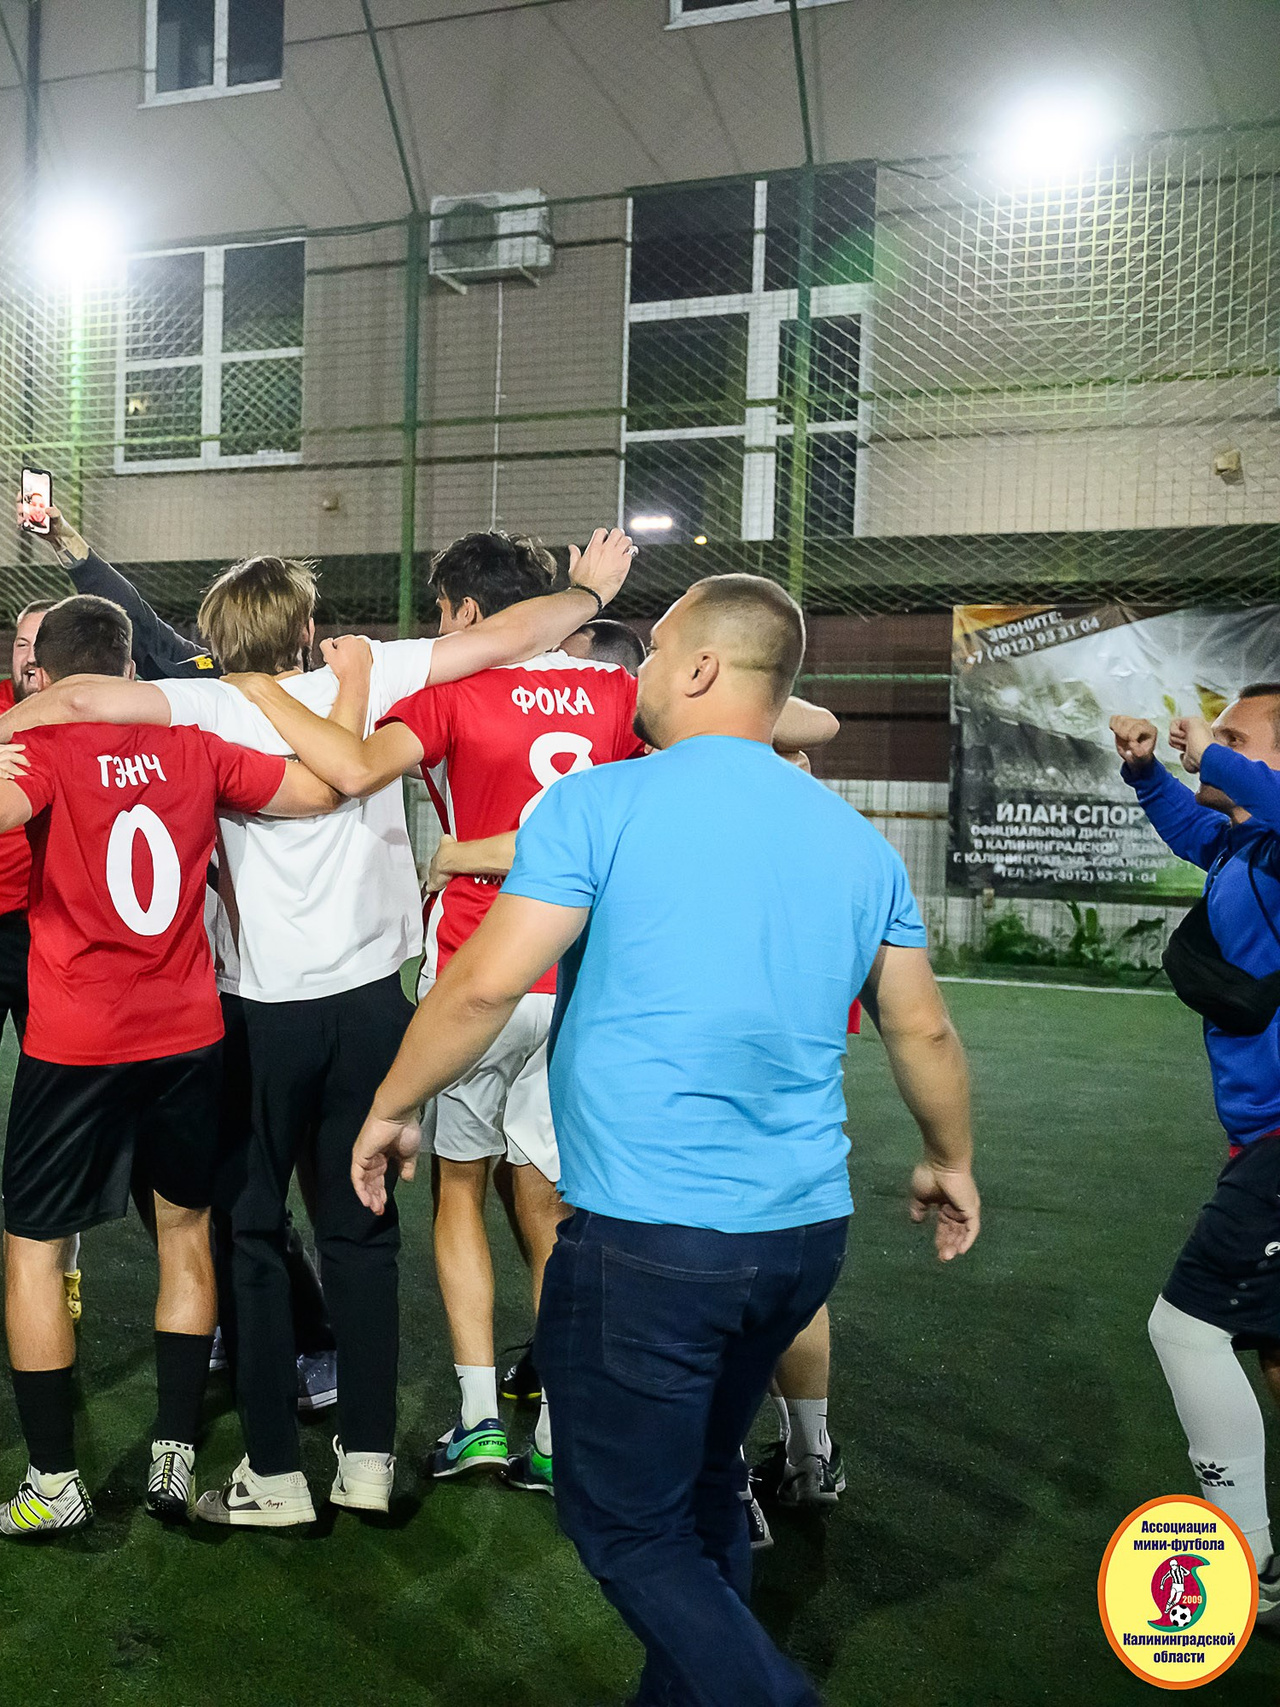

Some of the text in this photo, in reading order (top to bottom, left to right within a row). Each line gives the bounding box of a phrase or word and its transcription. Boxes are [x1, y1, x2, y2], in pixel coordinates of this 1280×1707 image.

[987, 611, 1062, 642] ЗВОНИТЕ:
[987, 635, 1035, 662] (4012)
[1058, 624, 1076, 639] 31
[1080, 616, 1099, 632] 04
[511, 685, 595, 716] ФОКА
[519, 731, 593, 830] 8
[996, 803, 1068, 824] ИЛАН
[970, 824, 1076, 838] ОФИЦИАЛЬНЫЙ
[106, 803, 181, 937] 0
